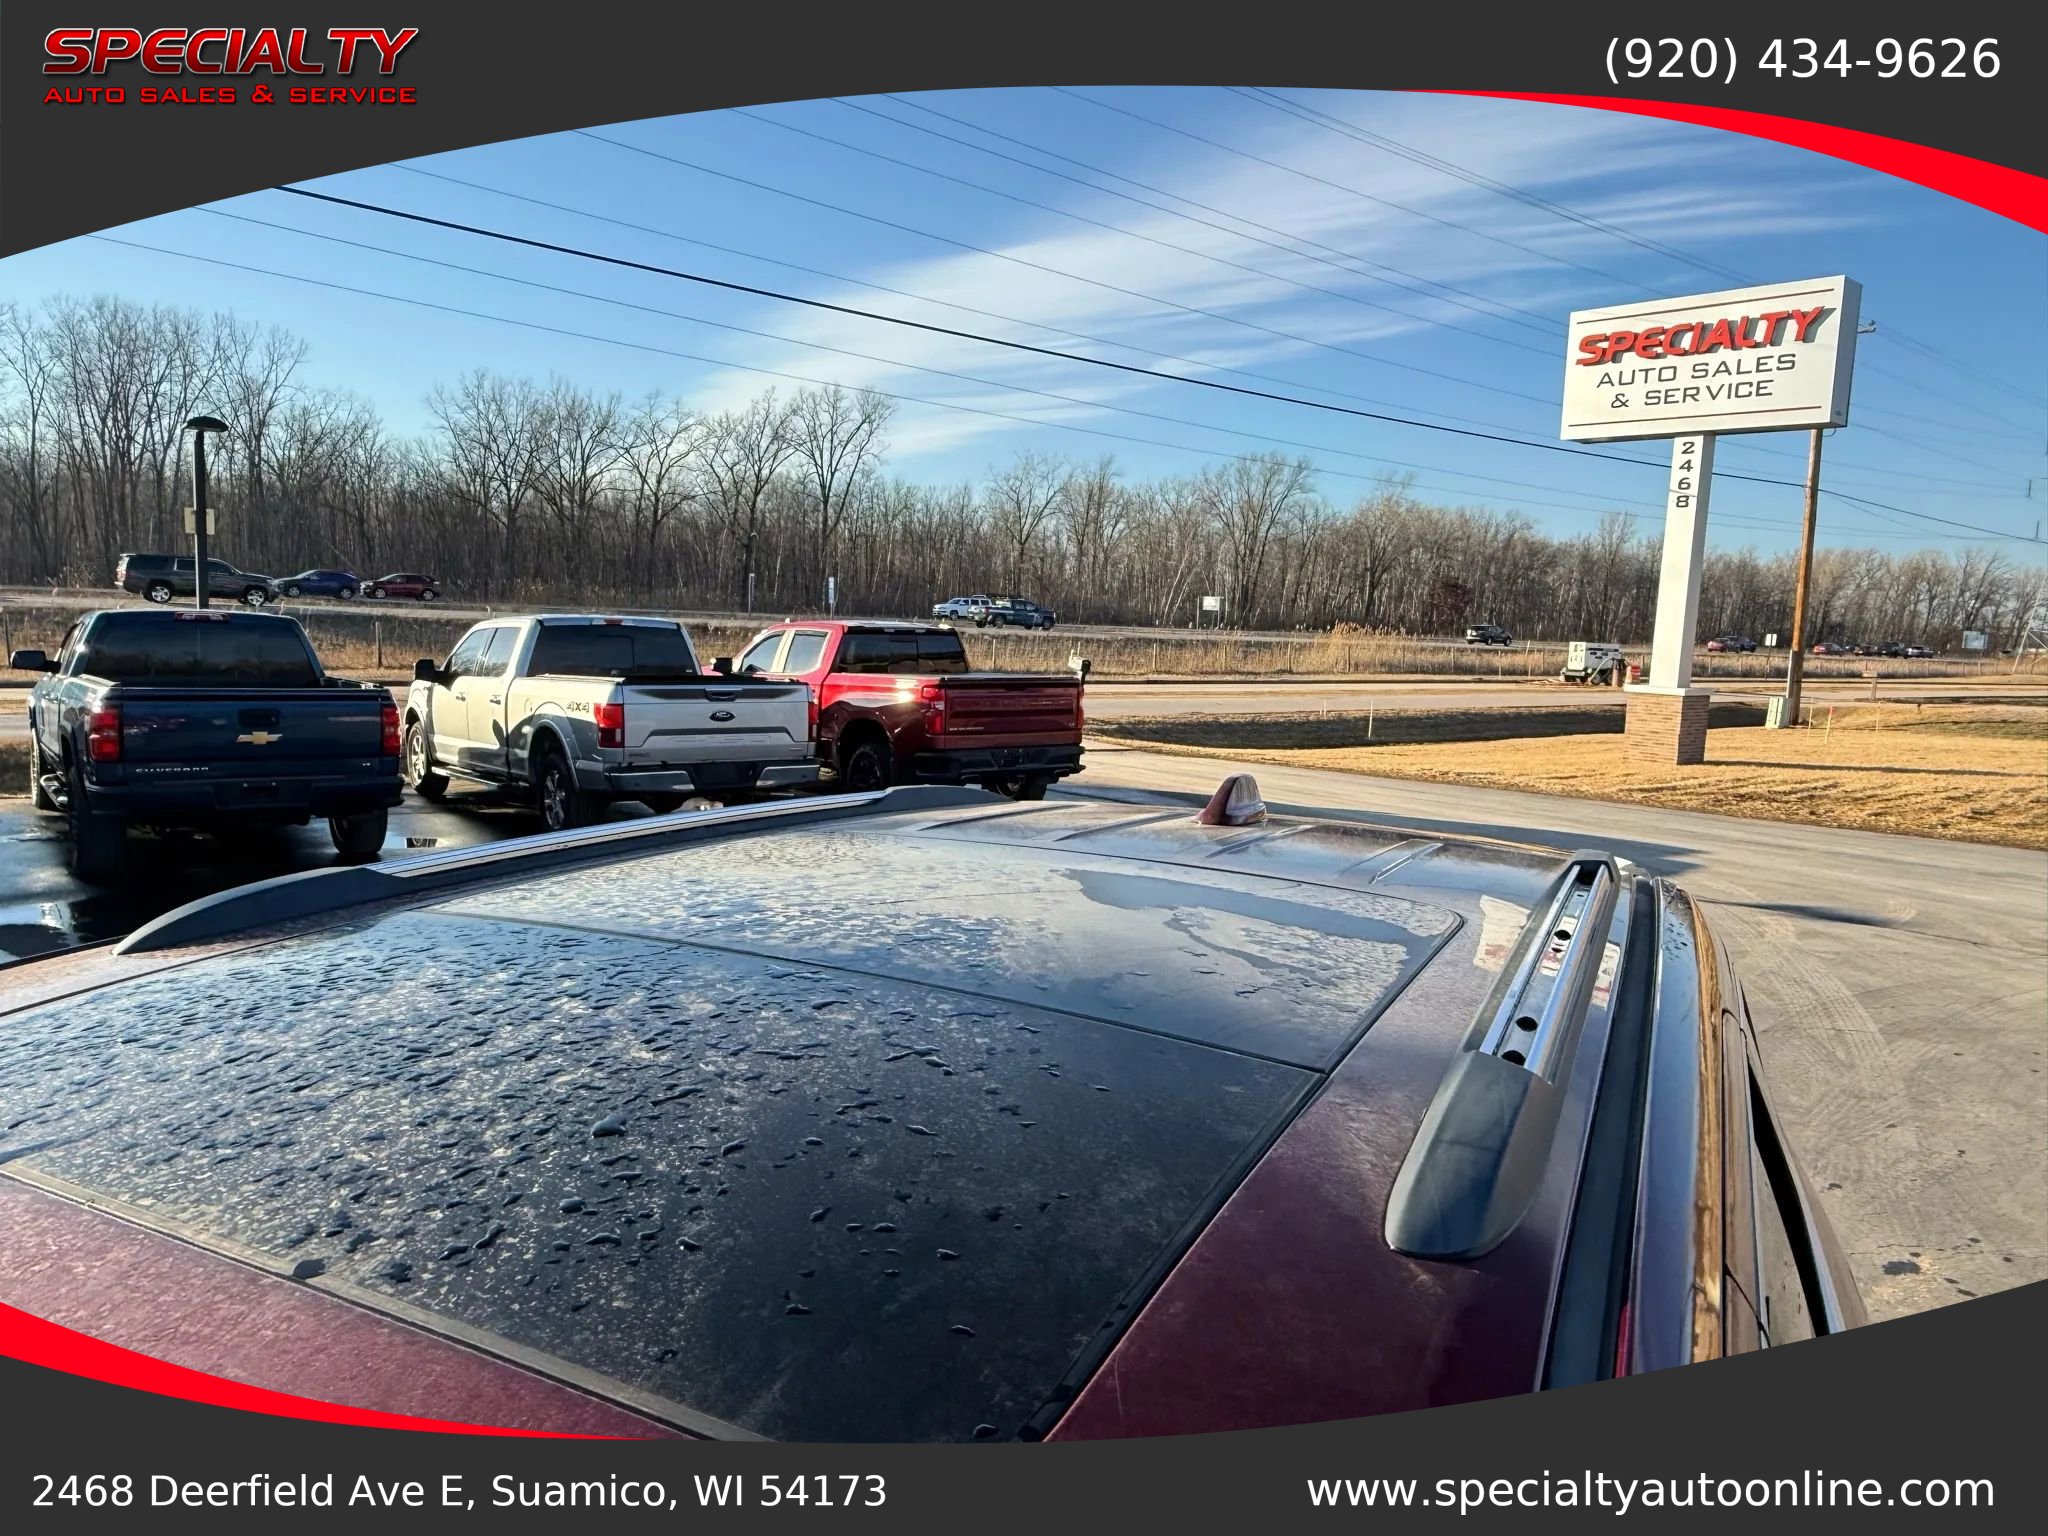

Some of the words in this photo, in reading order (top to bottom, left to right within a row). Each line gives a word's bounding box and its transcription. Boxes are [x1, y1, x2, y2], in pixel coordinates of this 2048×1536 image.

[1576, 306, 1829, 367] SPECIALTY
[1597, 365, 1677, 388] AUTO
[1691, 353, 1796, 380] SALES
[1611, 393, 1629, 408] &
[1644, 379, 1775, 406] SERVICE
[1675, 441, 1696, 509] 2468
